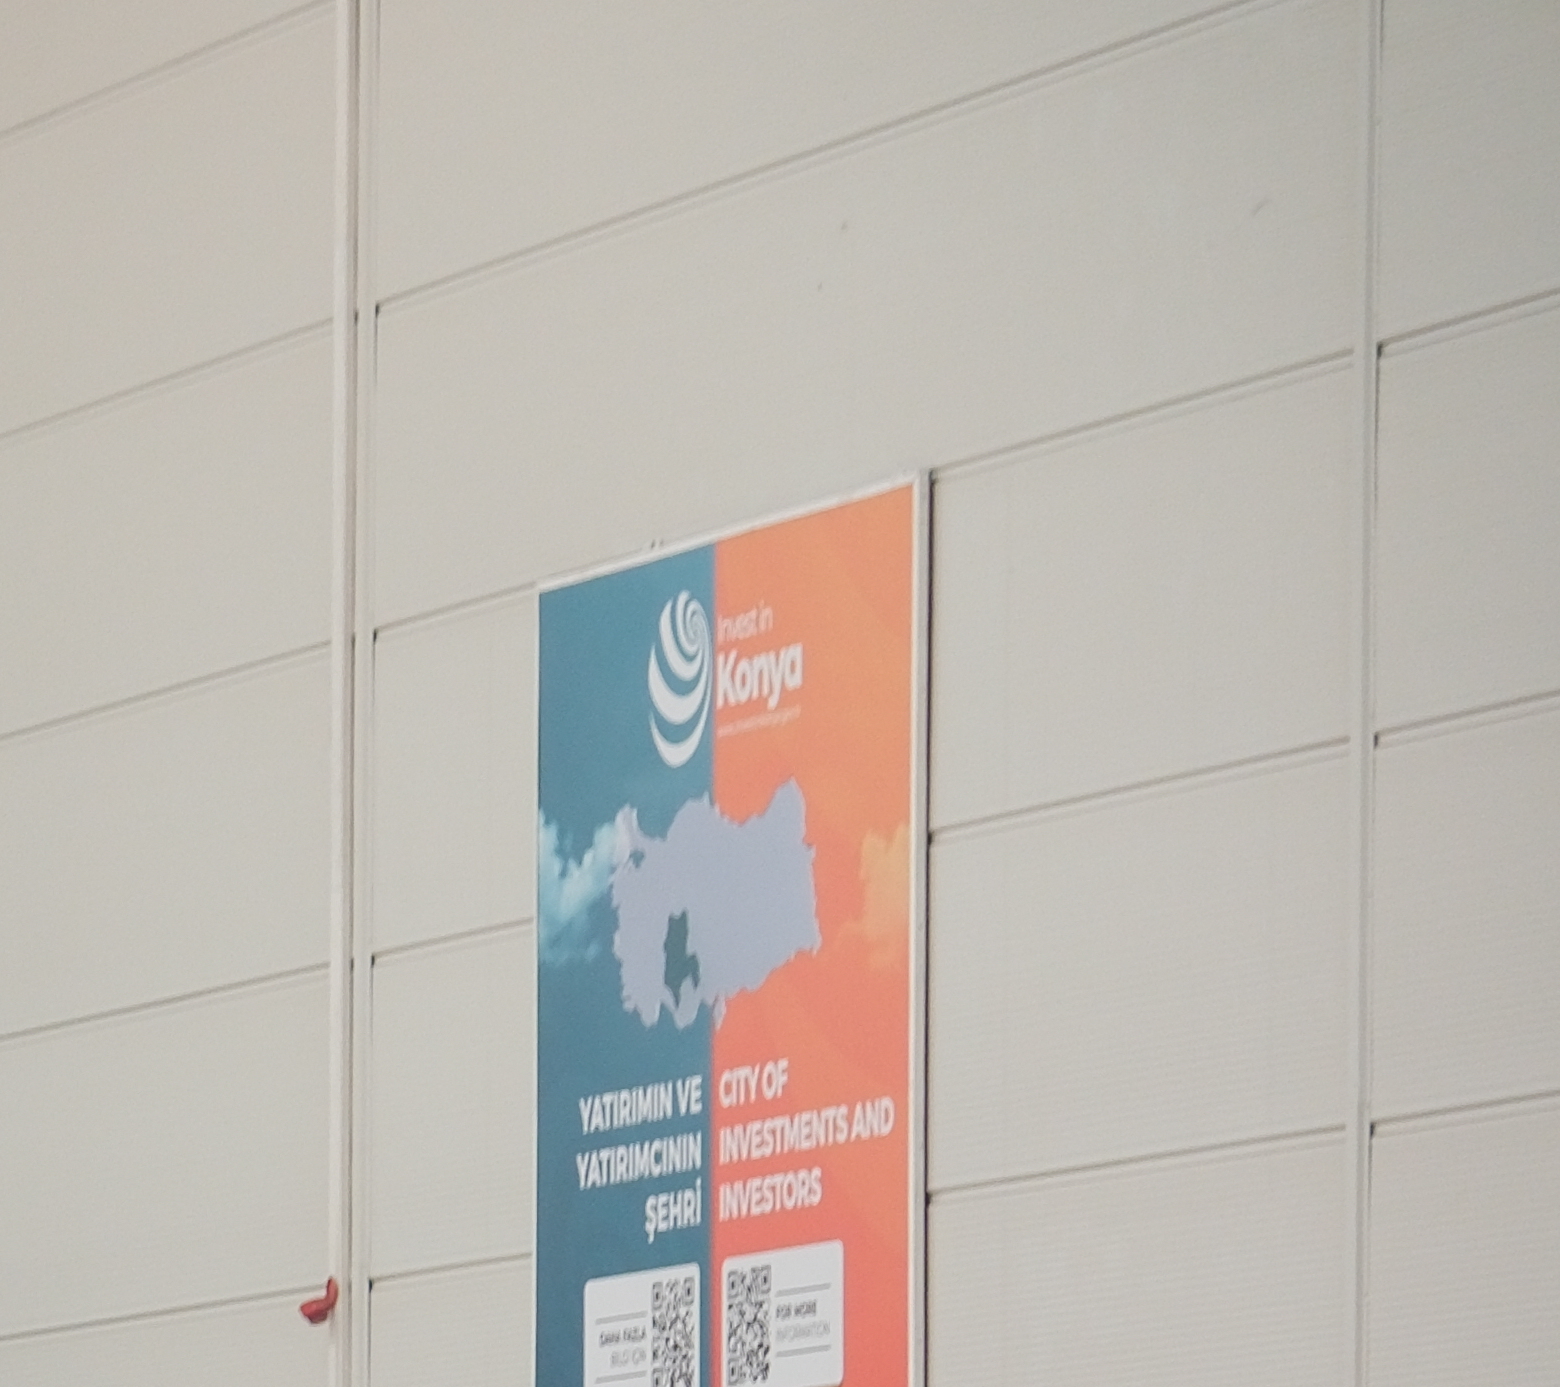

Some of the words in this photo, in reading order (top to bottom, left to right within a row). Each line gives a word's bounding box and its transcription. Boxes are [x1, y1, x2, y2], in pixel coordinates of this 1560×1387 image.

[716, 642, 804, 710] Konya
[578, 1080, 672, 1136] YATIRIMIN
[676, 1074, 703, 1117] VE
[720, 1063, 760, 1109] CITY
[761, 1057, 789, 1099] OF
[576, 1130, 702, 1191] YATIRIMCININ
[720, 1104, 849, 1166] INVESTMENTS
[851, 1096, 895, 1142] AND
[644, 1176, 702, 1244] ŞEHRİ
[719, 1166, 823, 1222] INVESTORS
